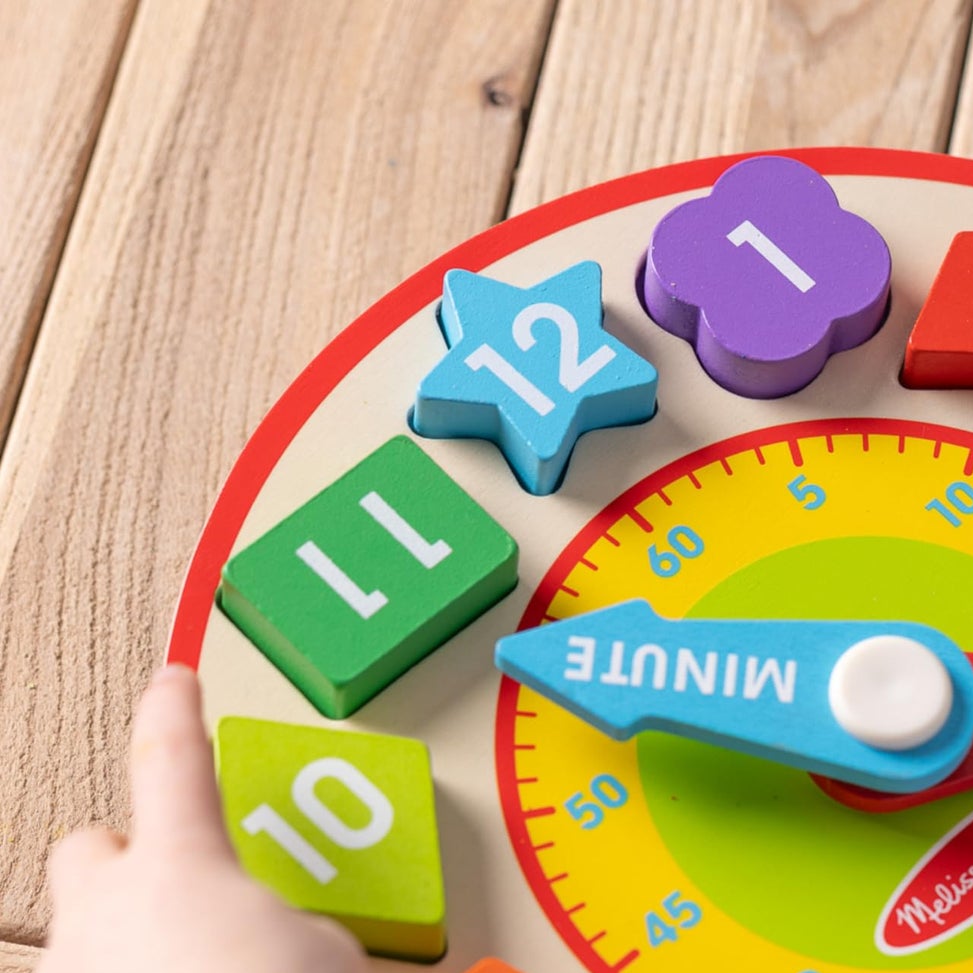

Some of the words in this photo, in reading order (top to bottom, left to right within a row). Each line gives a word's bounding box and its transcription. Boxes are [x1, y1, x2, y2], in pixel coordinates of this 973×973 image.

[725, 219, 817, 294] 1
[462, 301, 618, 418] 12
[788, 475, 826, 510] 5
[294, 489, 454, 620] 11
[648, 525, 704, 578] 60
[564, 635, 797, 704] MINUTE
[241, 756, 395, 883] 10
[565, 774, 628, 829] 50
[646, 891, 702, 947] 45
